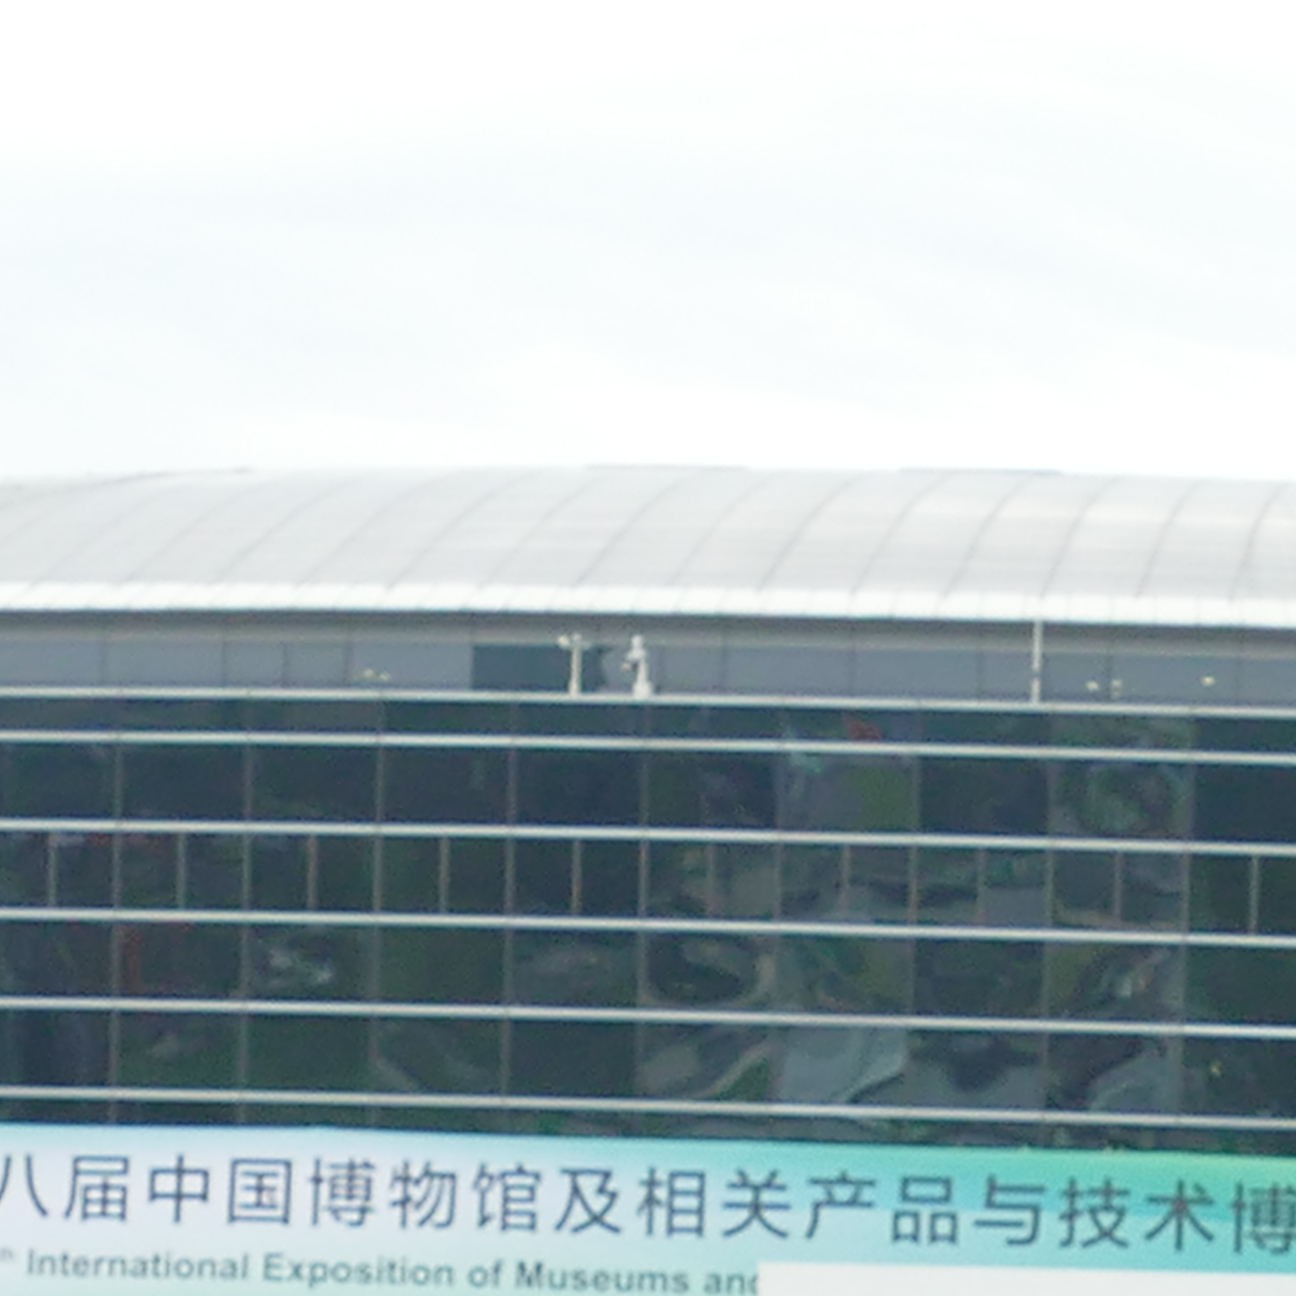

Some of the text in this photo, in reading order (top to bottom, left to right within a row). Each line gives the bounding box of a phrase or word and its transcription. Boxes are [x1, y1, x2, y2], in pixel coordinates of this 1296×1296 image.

[26, 1247, 251, 1281] International
[262, 1251, 455, 1290] Exposition
[467, 1257, 505, 1290] of
[515, 1261, 690, 1294] Museums
